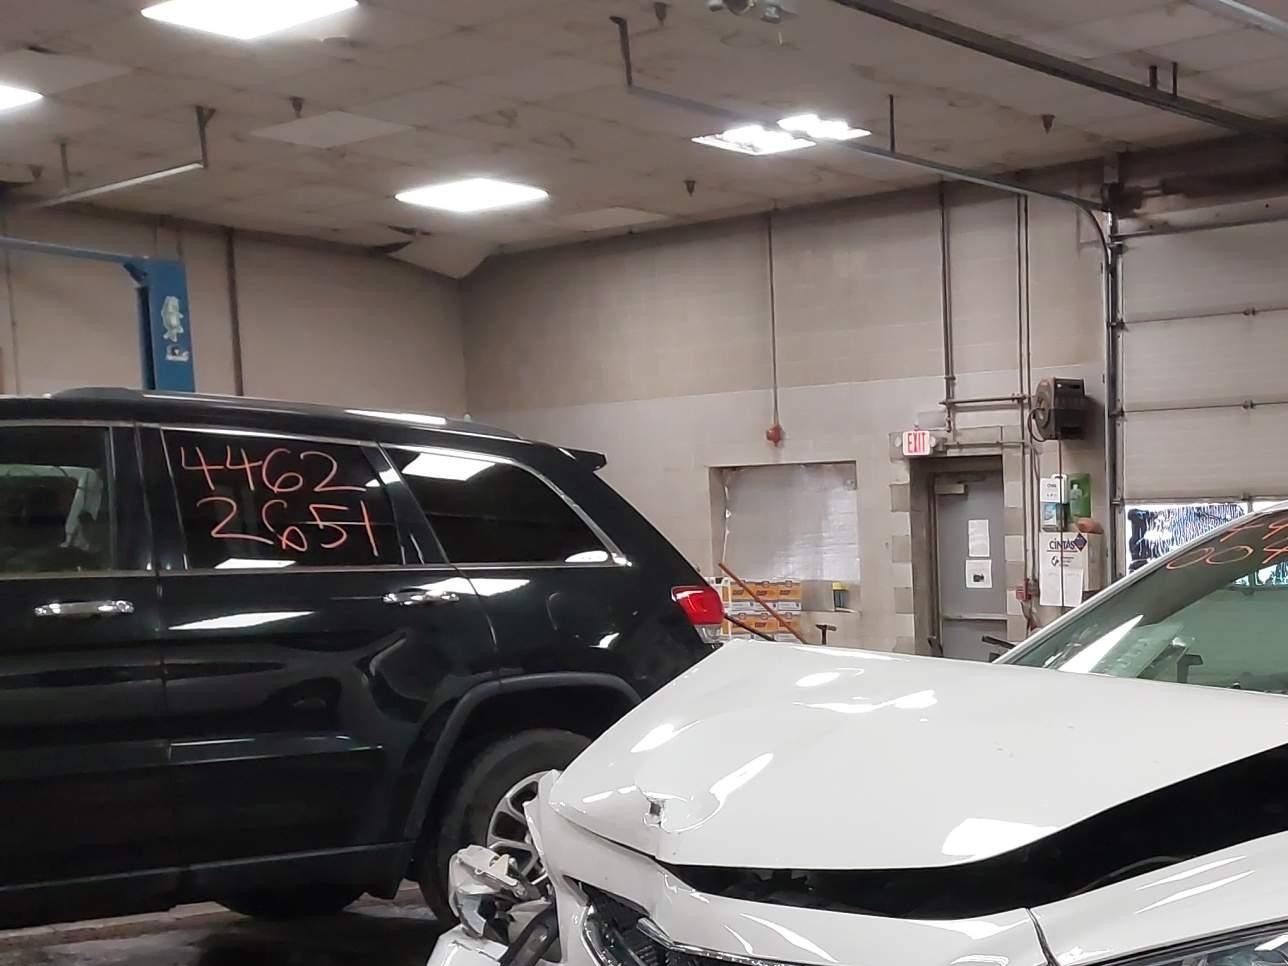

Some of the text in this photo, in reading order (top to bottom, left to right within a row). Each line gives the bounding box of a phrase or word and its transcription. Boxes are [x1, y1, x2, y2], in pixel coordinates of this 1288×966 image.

[907, 431, 925, 453] EXIT
[180, 445, 367, 493] 4462
[196, 496, 379, 557] 2651
[1049, 537, 1076, 550] CINTAS
